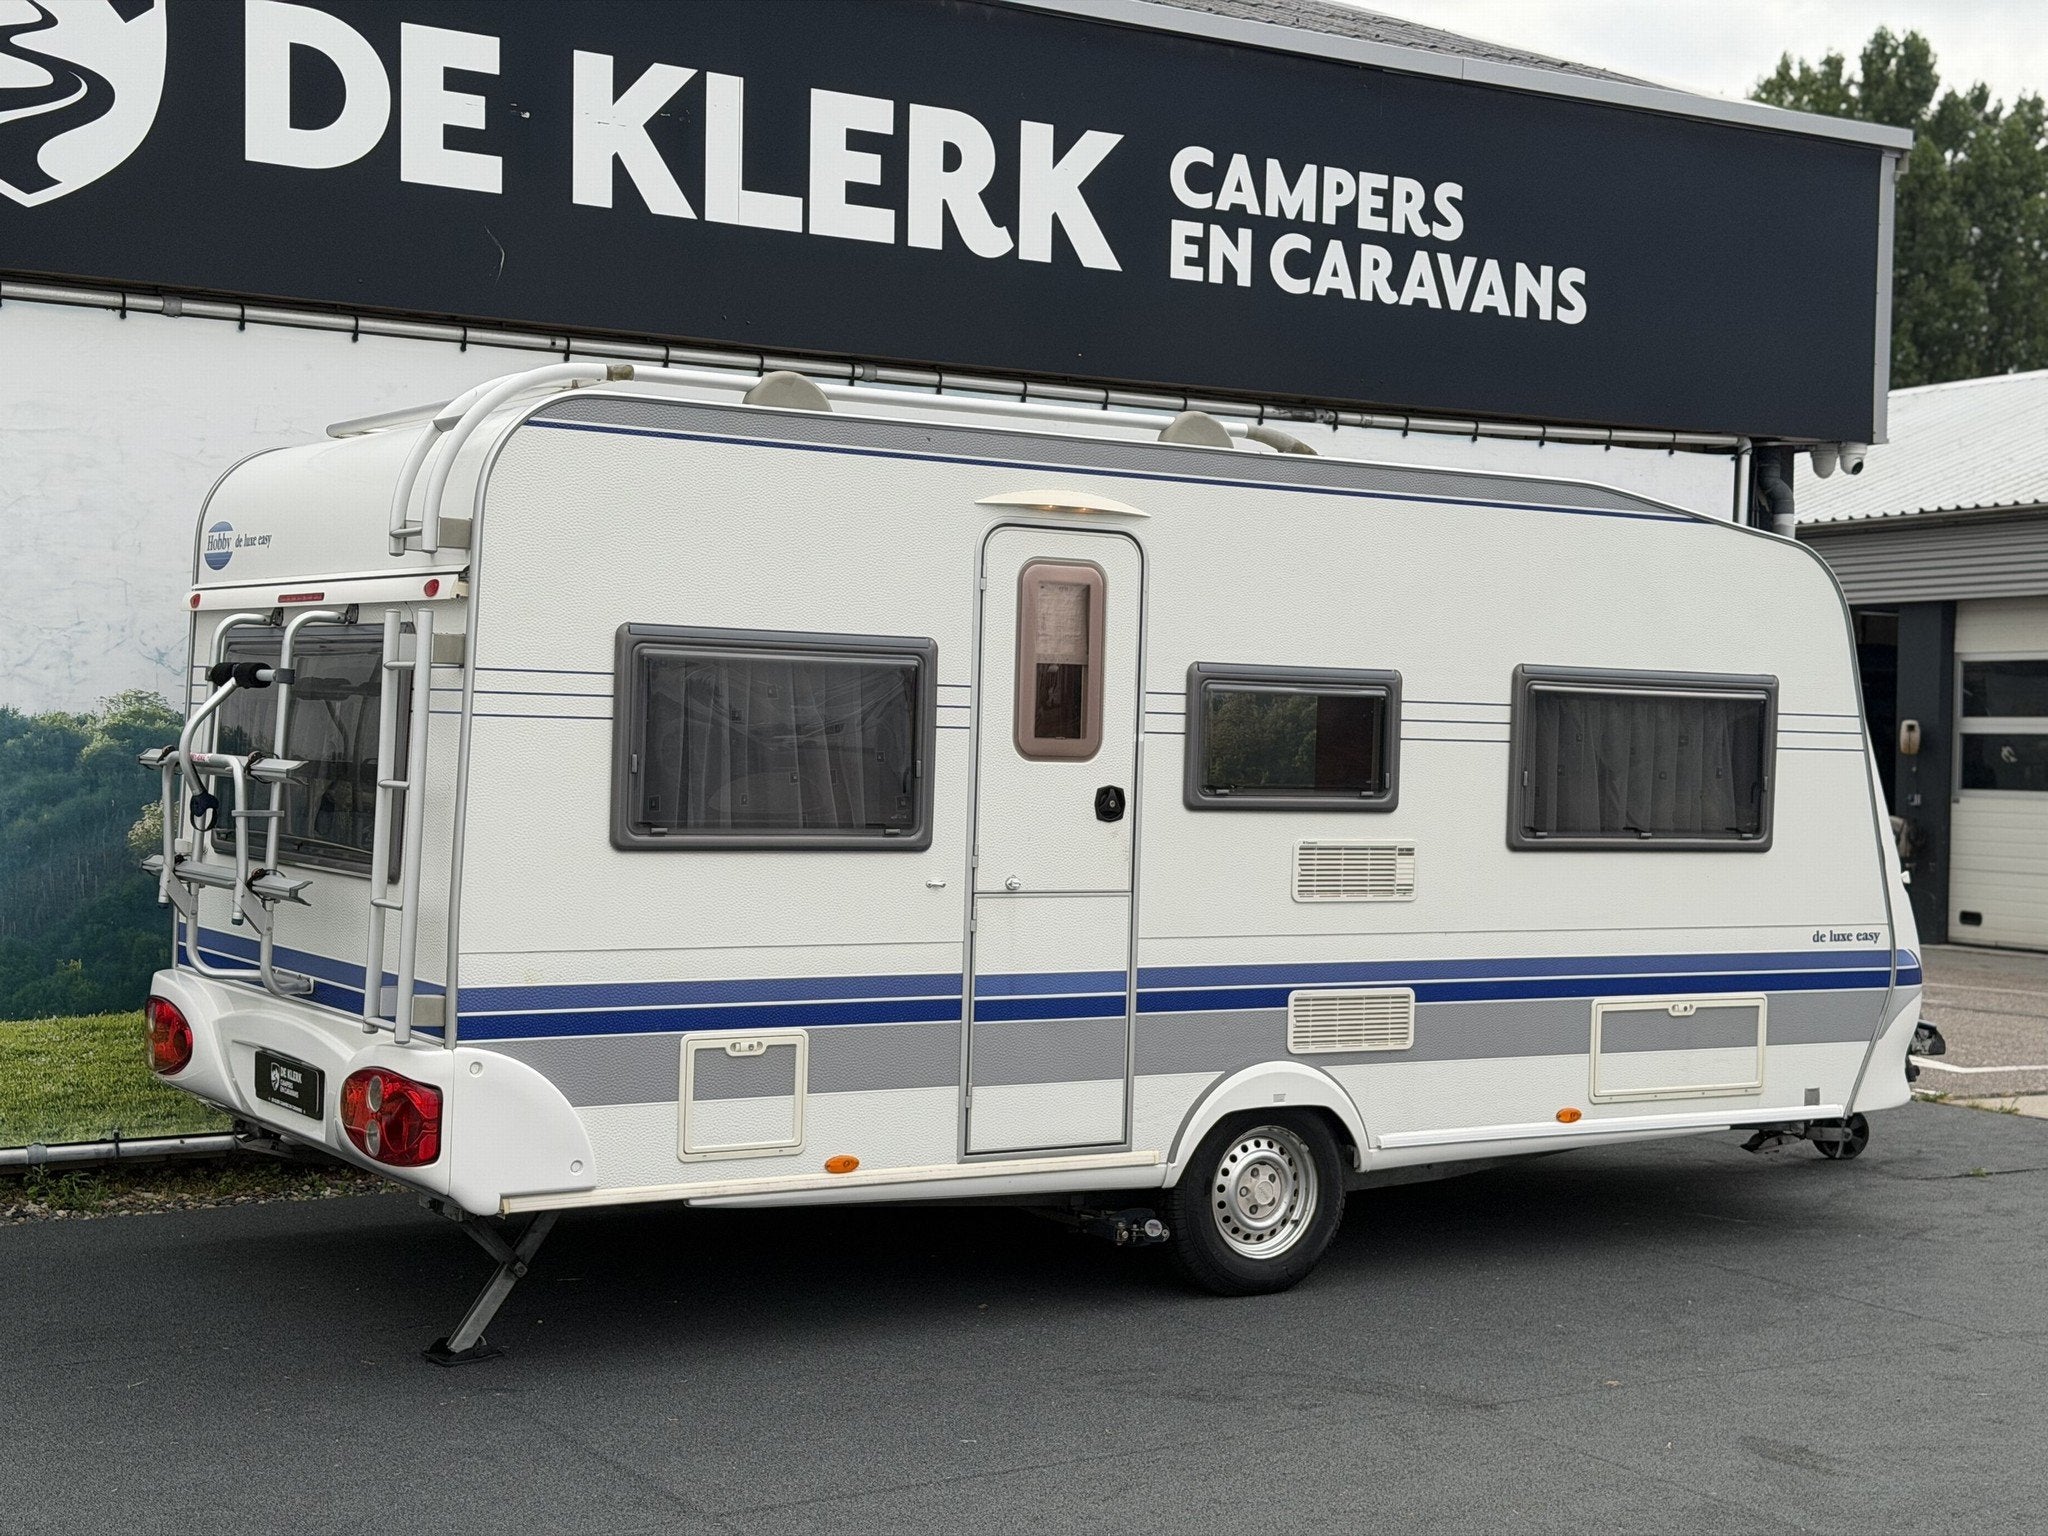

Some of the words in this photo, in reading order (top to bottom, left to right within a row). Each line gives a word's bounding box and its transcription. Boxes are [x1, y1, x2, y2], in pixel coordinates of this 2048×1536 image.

[245, 0, 502, 194] DE
[573, 50, 1124, 271] KLERK
[1170, 146, 1463, 241] CAMPERS
[1170, 219, 1252, 287] EN
[1270, 233, 1586, 324] CARAVANS
[207, 533, 230, 551] Hobby
[235, 534, 243, 548] de
[244, 534, 257, 547] luxe
[258, 534, 272, 548] easy
[1812, 930, 1826, 943] de
[1829, 930, 1853, 942] luxe
[1856, 931, 1880, 944] easy
